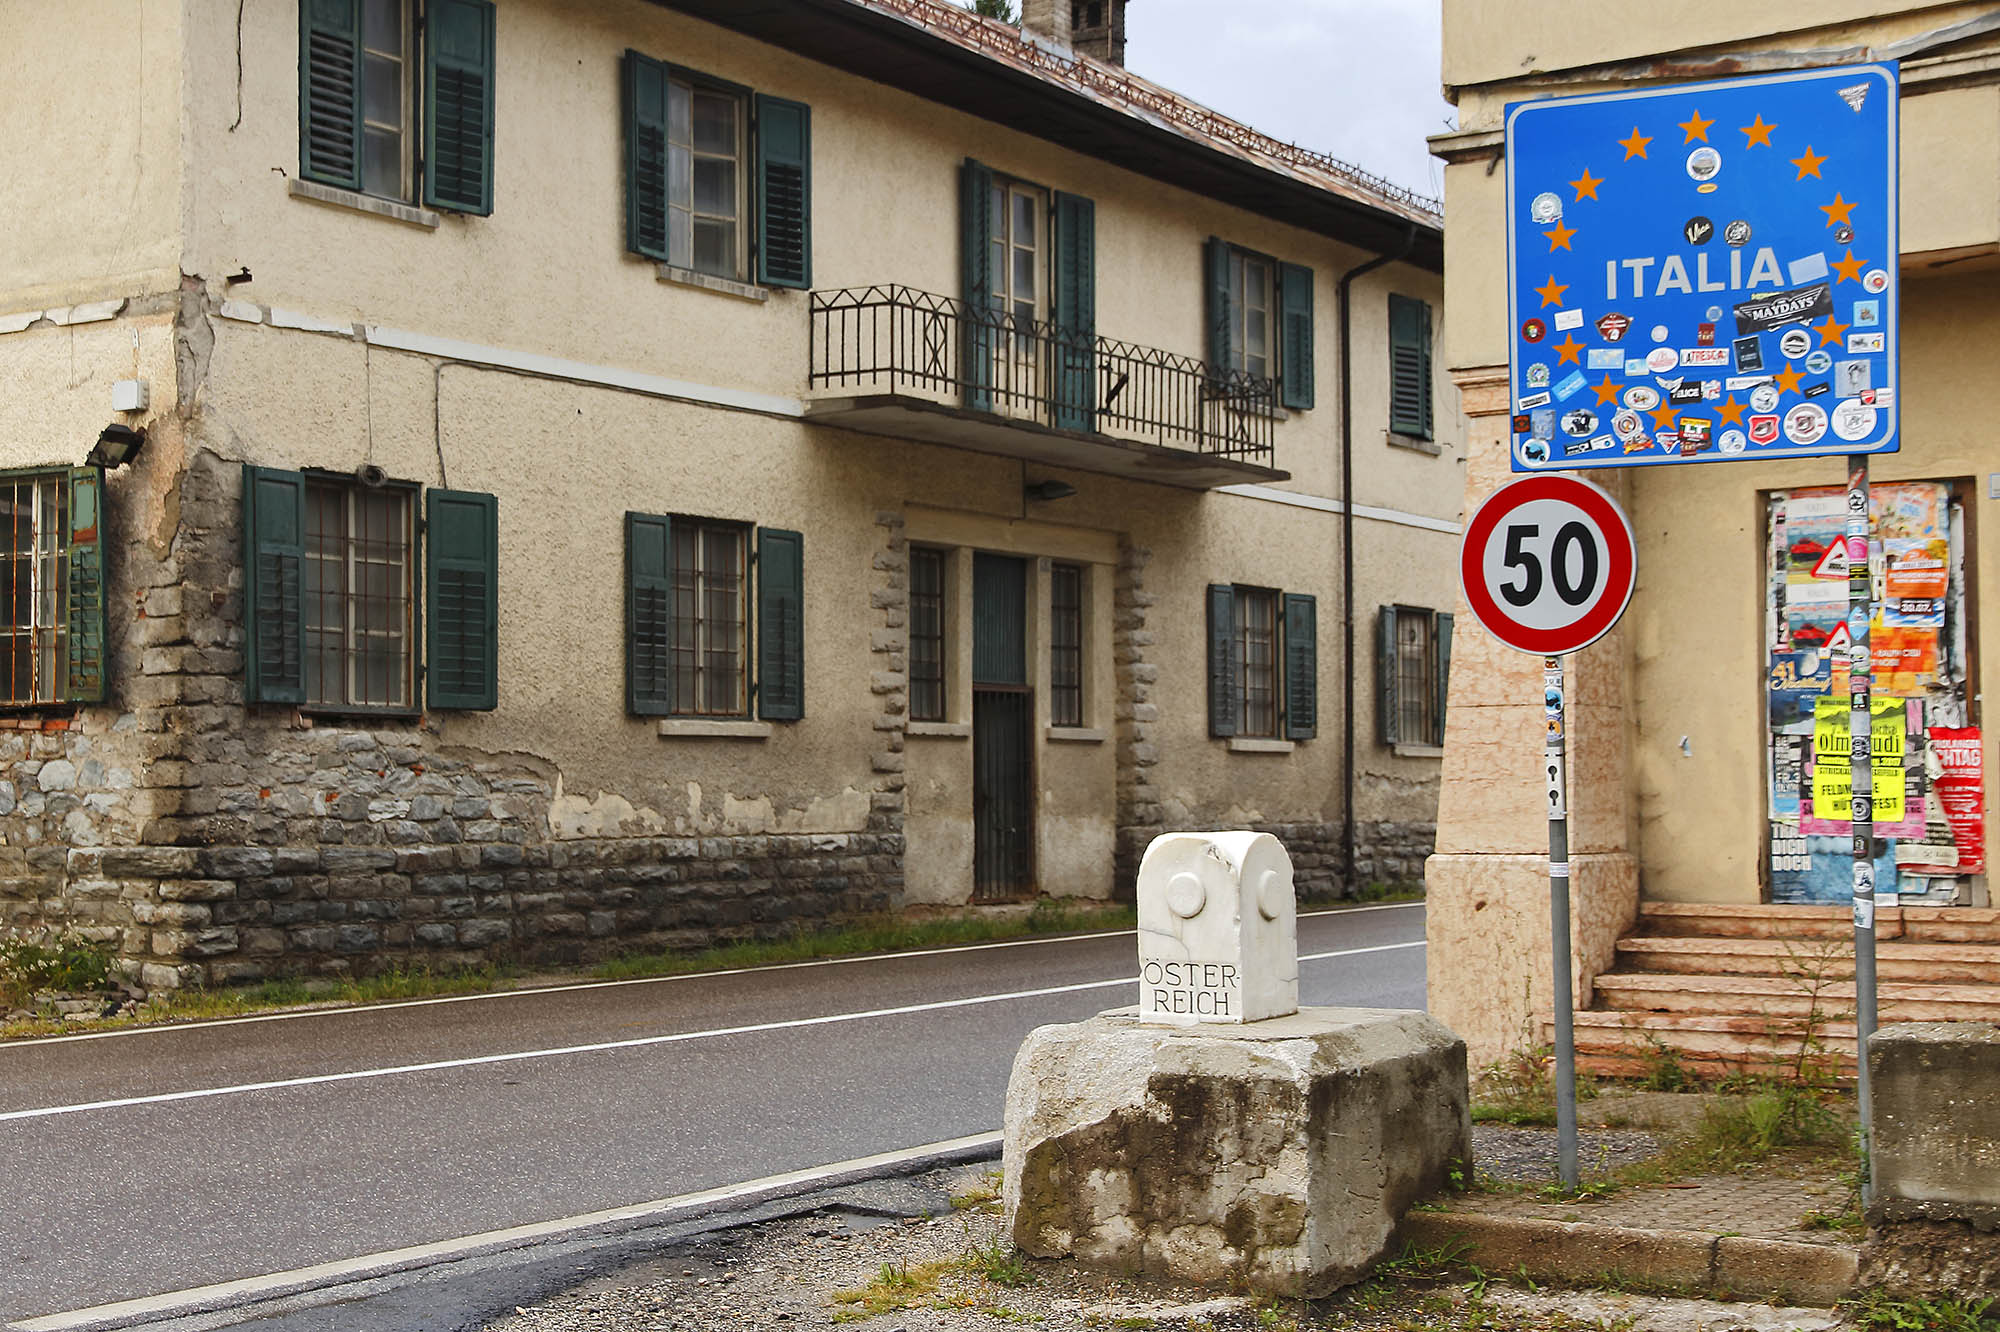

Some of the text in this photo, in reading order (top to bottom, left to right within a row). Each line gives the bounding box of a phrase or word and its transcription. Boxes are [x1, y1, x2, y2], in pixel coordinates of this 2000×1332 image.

[1606, 246, 1785, 300] ITALIA
[1752, 296, 1816, 321] MAYDAYS
[1499, 520, 1598, 606] 50
[1772, 855, 1812, 871] DOCH
[1144, 957, 1241, 989] ÖSTER-
[1154, 989, 1230, 1016] REICH
